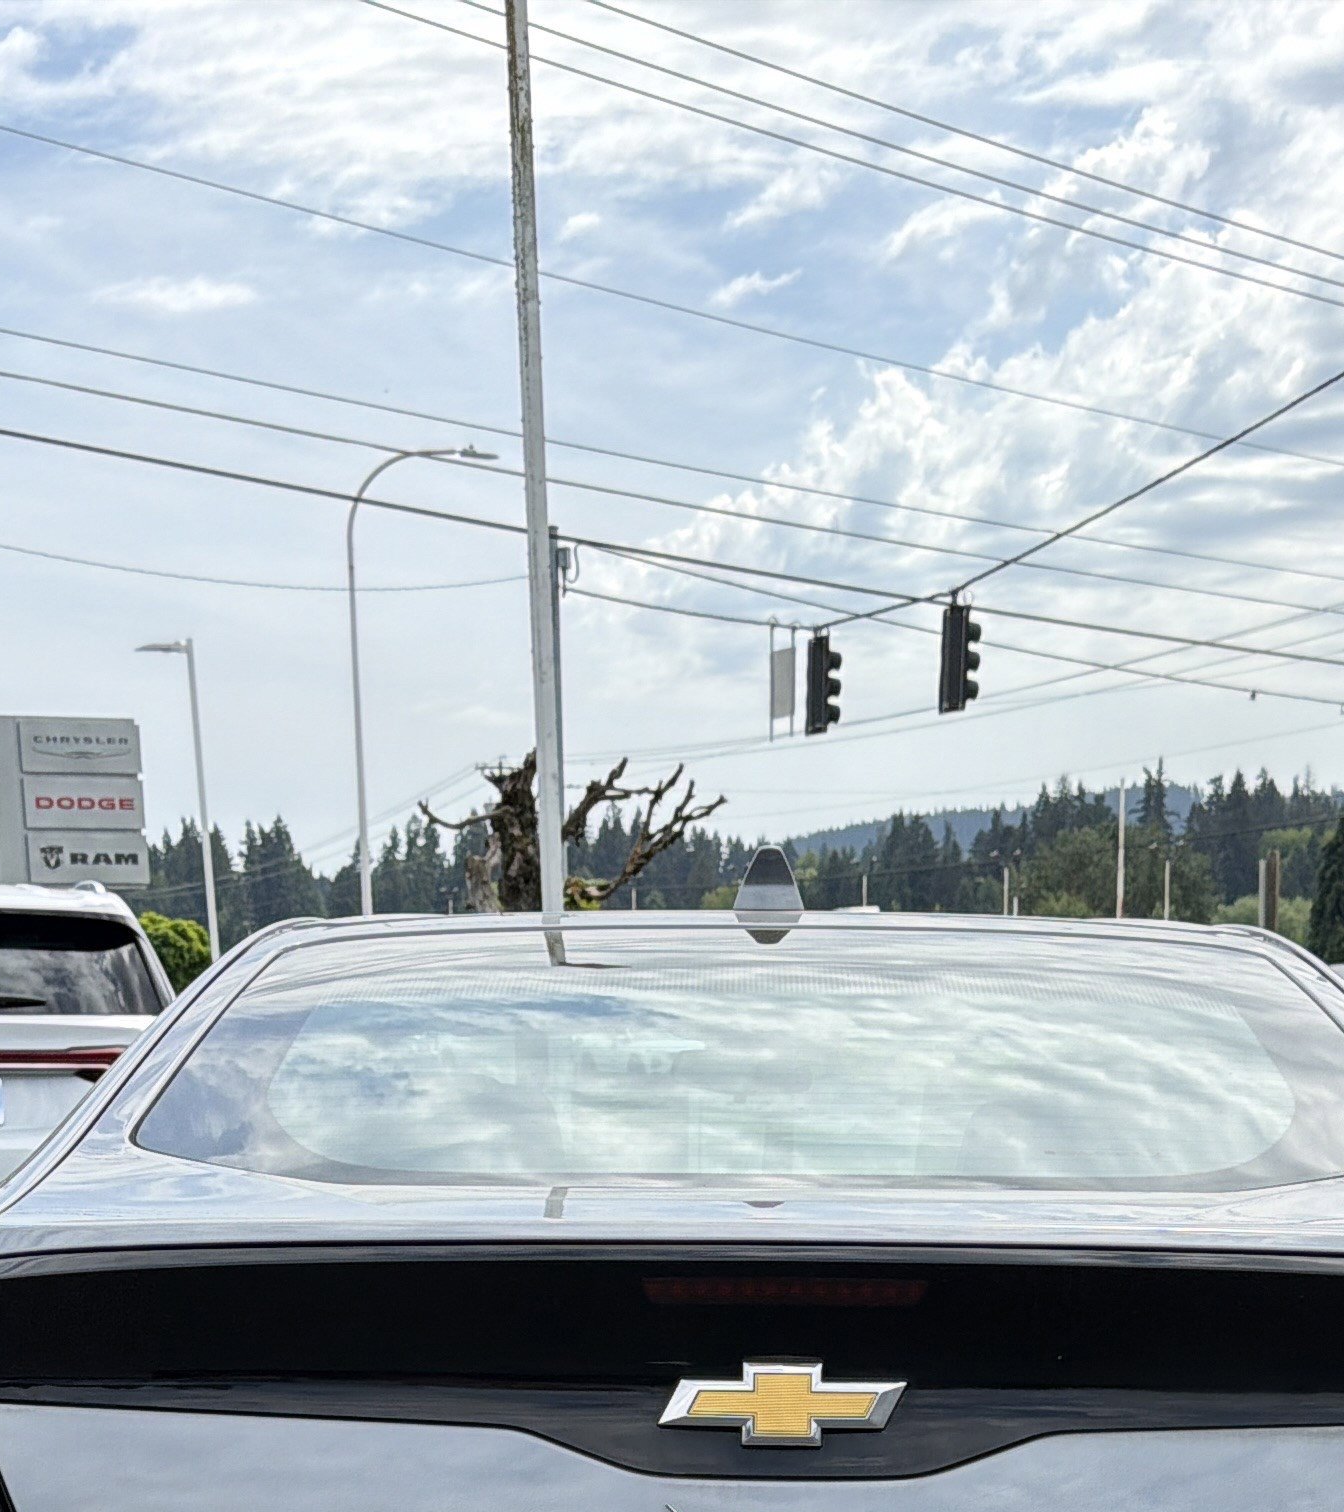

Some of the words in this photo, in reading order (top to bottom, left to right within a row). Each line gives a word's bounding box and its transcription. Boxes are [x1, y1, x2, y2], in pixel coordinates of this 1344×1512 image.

[32, 735, 129, 746] CHRYSLER
[34, 796, 136, 811] DODGE
[69, 852, 140, 866] RAM
